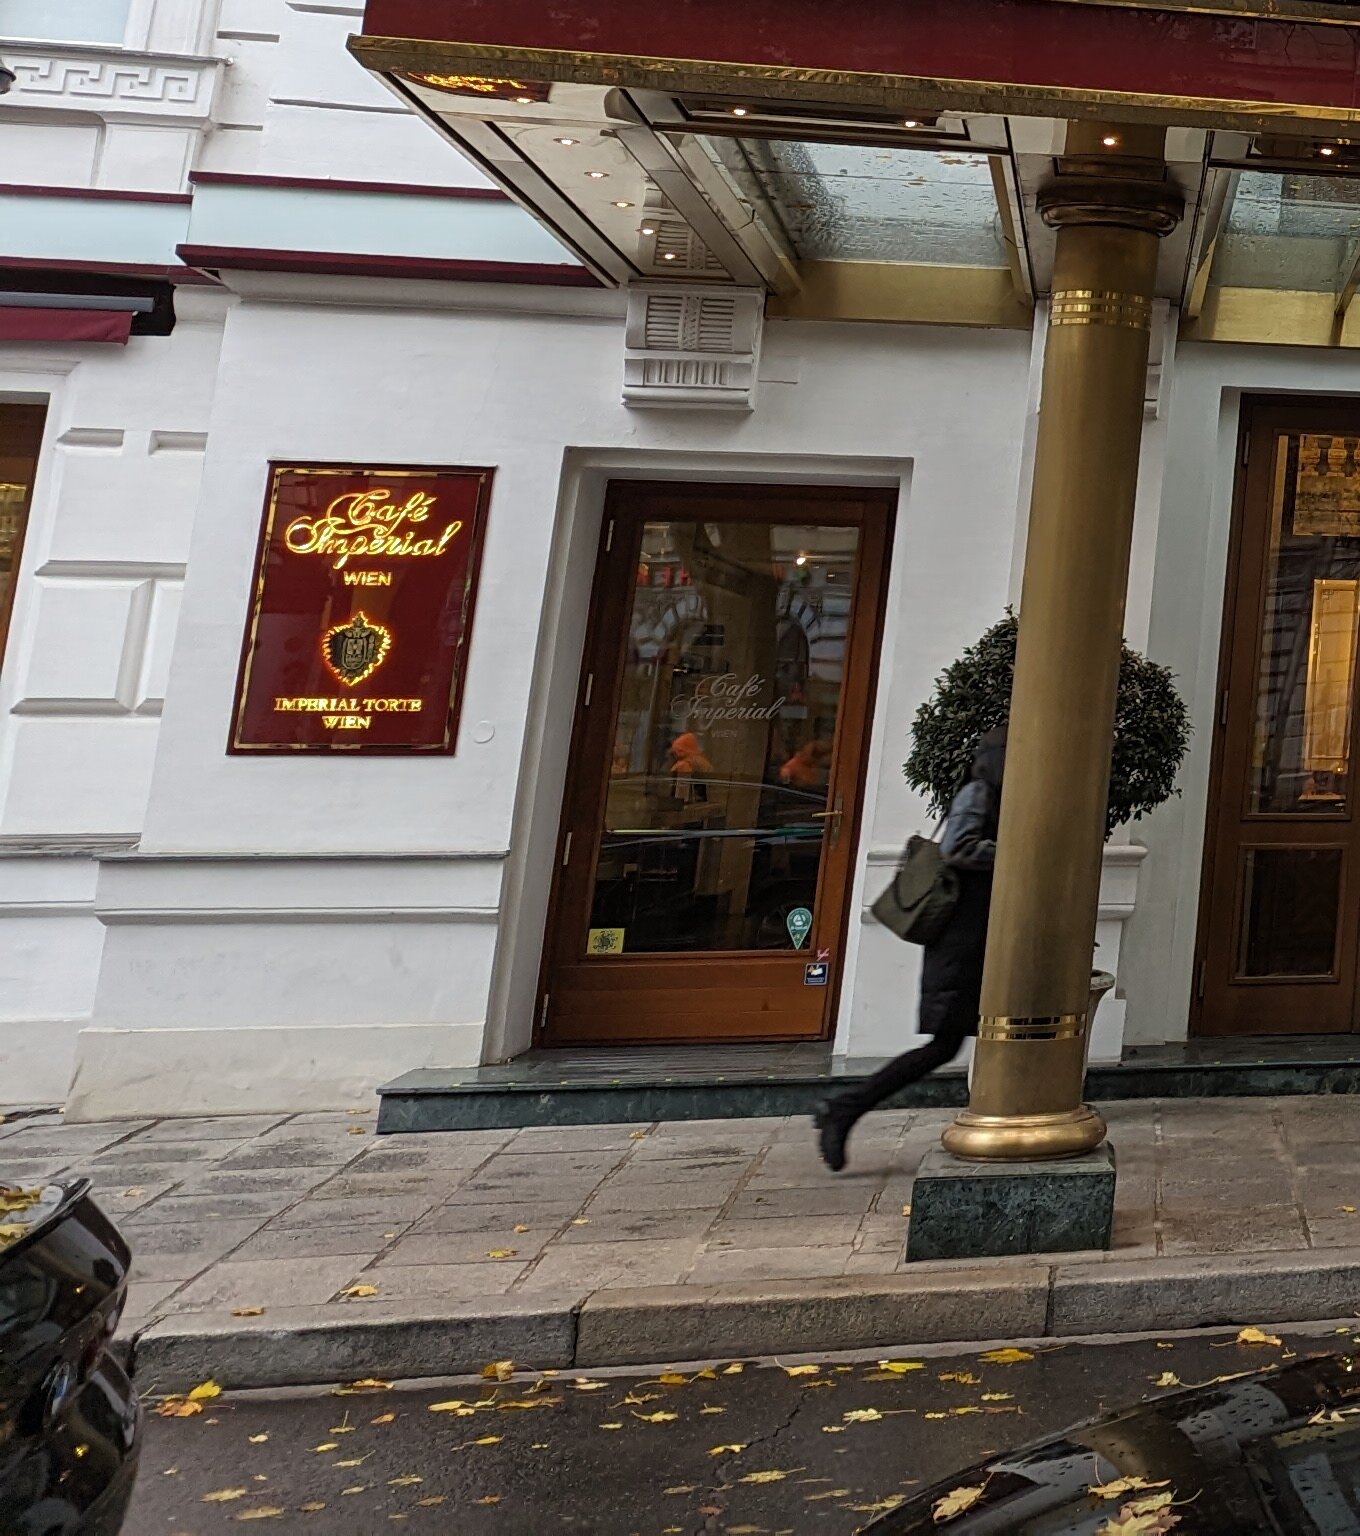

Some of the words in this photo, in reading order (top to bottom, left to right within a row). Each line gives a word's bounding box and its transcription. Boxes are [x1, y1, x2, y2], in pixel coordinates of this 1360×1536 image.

[326, 489, 437, 536] Café
[285, 516, 463, 569] Imperial
[344, 571, 392, 586] WIEN
[274, 697, 360, 712] IMPERIAL
[363, 698, 422, 712] TORTE
[695, 673, 766, 707] Café
[322, 715, 372, 729] WIEN
[670, 694, 786, 730] Imperial
